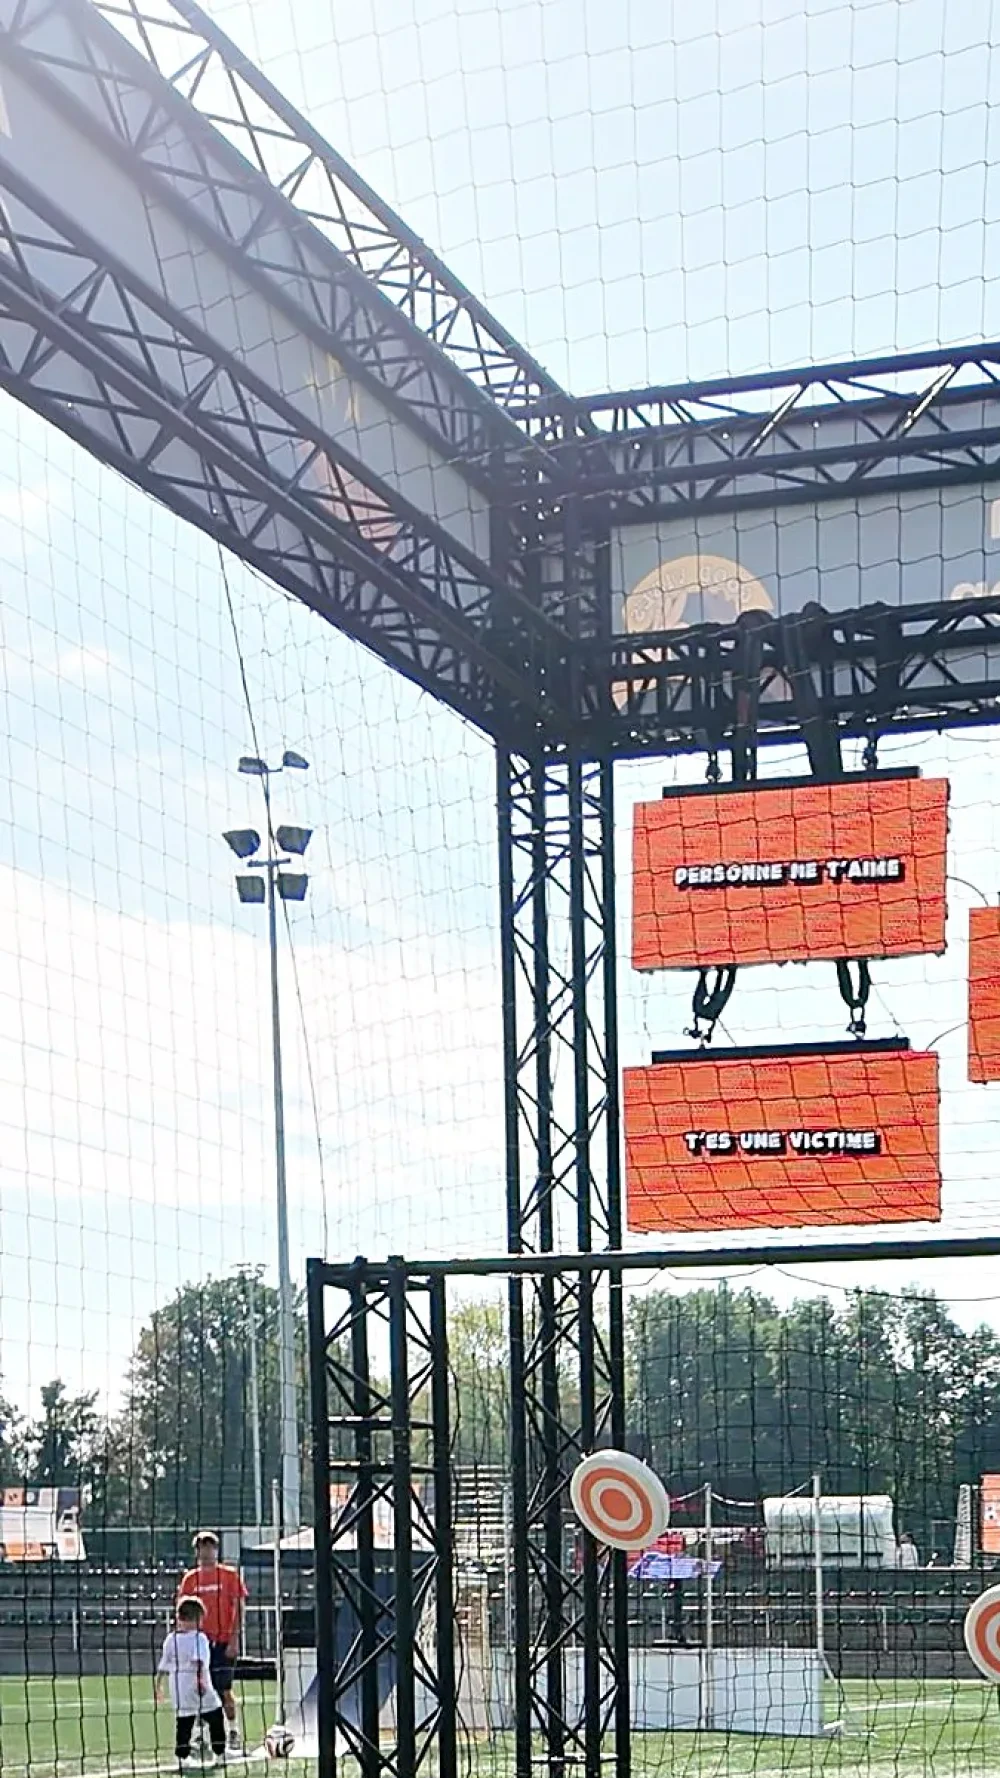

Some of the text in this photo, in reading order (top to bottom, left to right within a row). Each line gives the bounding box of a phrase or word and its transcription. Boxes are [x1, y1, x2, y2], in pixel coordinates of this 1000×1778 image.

[674, 862, 784, 887] PERSONNE
[789, 859, 818, 881] NE
[684, 1129, 877, 1151] T'ES UNE VICTIME
